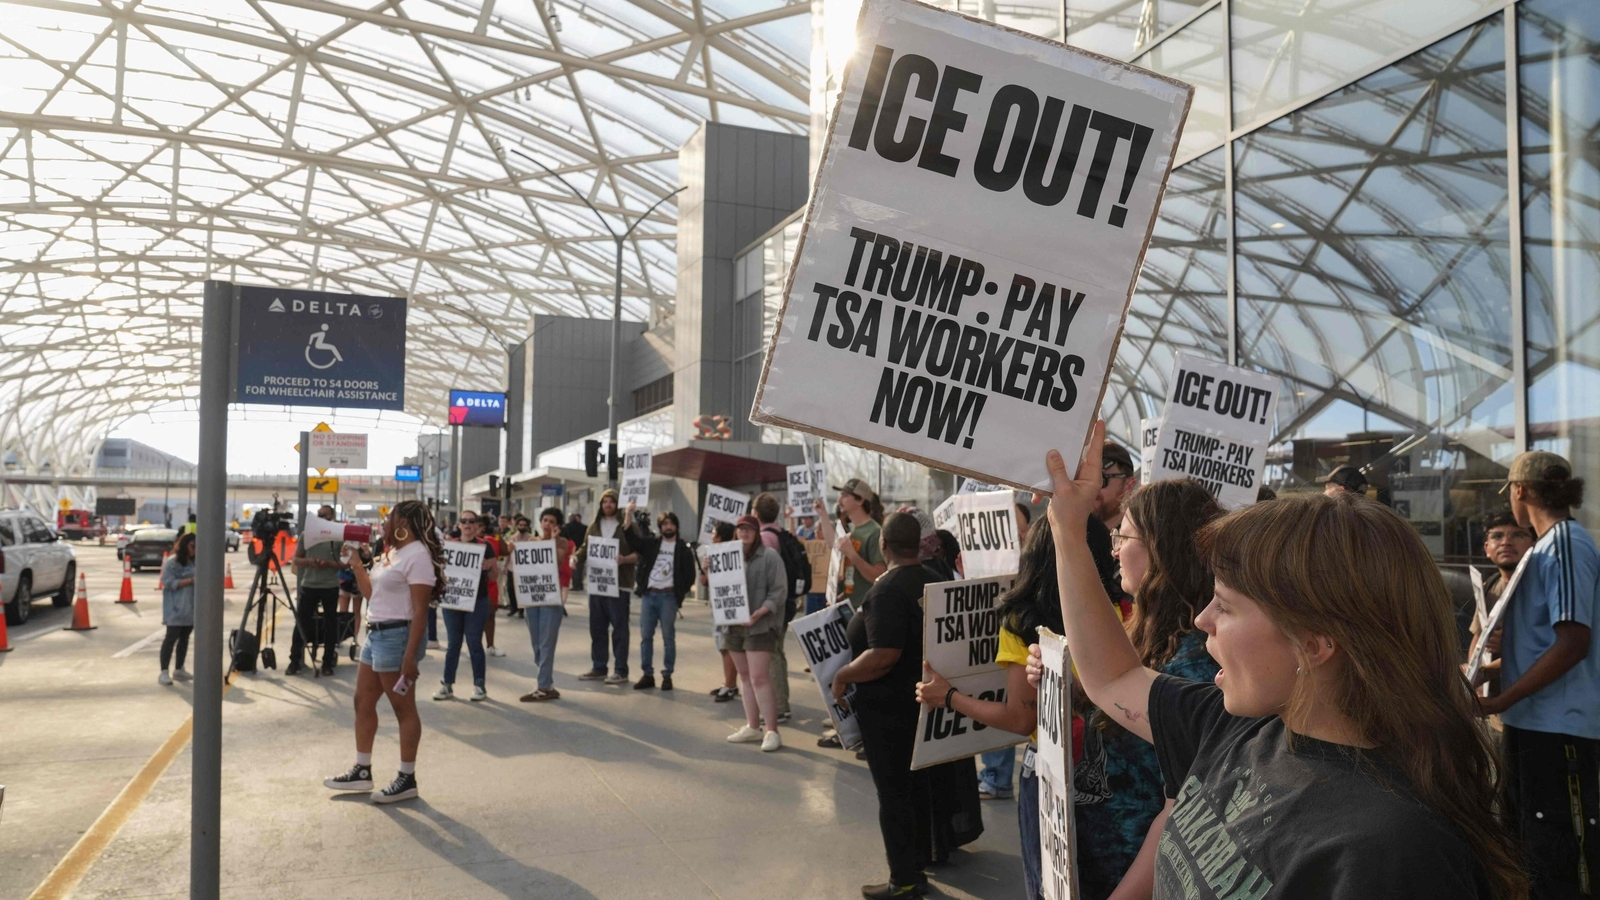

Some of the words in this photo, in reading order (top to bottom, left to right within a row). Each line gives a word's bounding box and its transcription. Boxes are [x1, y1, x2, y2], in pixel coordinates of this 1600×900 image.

[848, 45, 984, 178] ICE
[973, 83, 1155, 229] OUT!
[843, 226, 999, 326] TRUMP:
[999, 273, 1087, 347] PAY
[292, 299, 362, 317] DELTA
[807, 282, 883, 358] TSA
[887, 305, 1086, 412] WORKERS
[245, 385, 266, 395] FOR
[268, 386, 335, 399] WHEELCHAIR
[337, 389, 398, 401] ASSISTANCE
[263, 375, 311, 387] PROCEED
[313, 378, 328, 388] TO
[343, 380, 379, 390] DOORS
[466, 397, 500, 408] DELTA
[869, 366, 988, 450] NOW!
[1173, 369, 1215, 411] ICE
[1213, 379, 1272, 425] OUT!
[1142, 427, 1158, 449] ICE
[1173, 428, 1225, 461] TRUMP:
[1226, 442, 1254, 467] PAY
[626, 455, 636, 469] ICE
[1162, 448, 1189, 473] TSA
[1188, 458, 1255, 489] WORKERS
[789, 471, 803, 485] ICE
[708, 492, 723, 510] ICE
[722, 497, 744, 516] OUT!
[957, 512, 981, 551] ICE
[978, 509, 1014, 551] OUT!
[443, 549, 455, 566] CE
[455, 550, 480, 570] OUT!
[514, 549, 530, 566] ICE
[530, 547, 554, 565] OUT!
[589, 543, 600, 558] ICE
[709, 553, 722, 574] ICE
[721, 549, 742, 572] OUT!
[800, 627, 831, 665] ICE
[823, 619, 850, 655] OU
[935, 614, 965, 644] TSA
[969, 636, 1000, 667] NO
[1168, 845, 1192, 889] HAWAII
